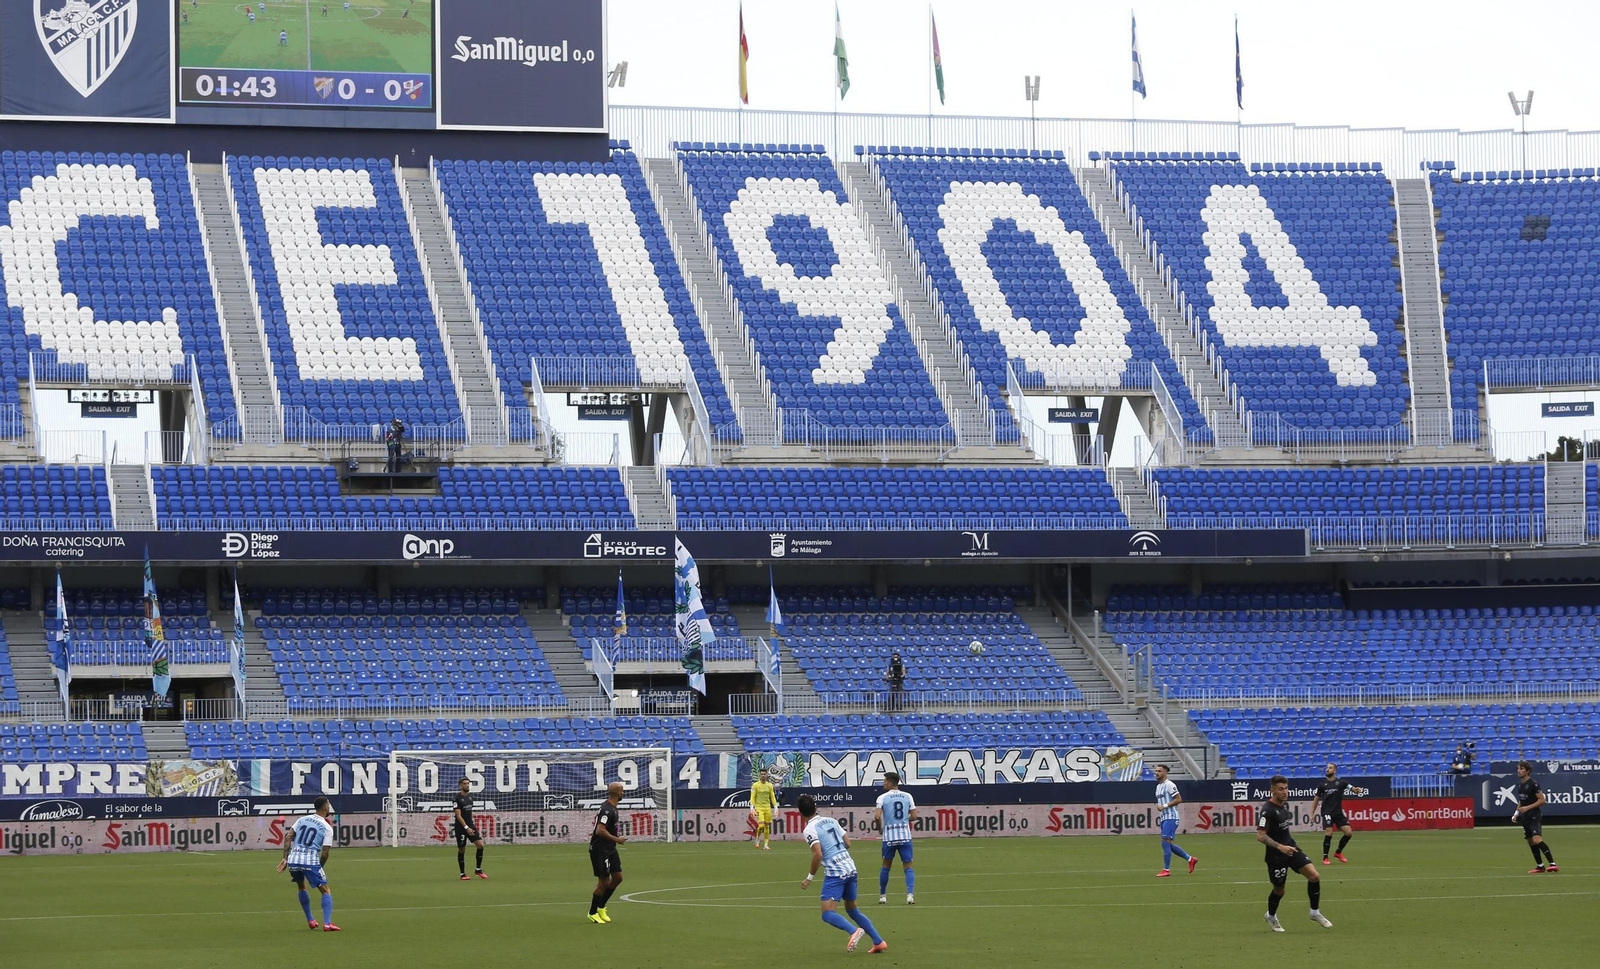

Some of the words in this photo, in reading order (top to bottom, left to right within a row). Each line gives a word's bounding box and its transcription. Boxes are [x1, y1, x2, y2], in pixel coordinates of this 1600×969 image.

[573, 49, 595, 64] 0,0
[196, 74, 276, 98] 01:43
[337, 78, 355, 100] 0
[383, 79, 401, 101] 0
[533, 174, 1378, 388] 1904
[3, 535, 39, 547] DOÑA
[42, 537, 126, 548] FRANCISQUITA
[251, 533, 279, 542] Diego
[251, 541, 272, 549] Díaz
[791, 539, 832, 547] Ayuntamiento
[45, 548, 84, 557] catering
[251, 549, 280, 558] López
[604, 547, 666, 556] PROTEC
[800, 546, 822, 555] Málaga
[291, 762, 439, 795] FONDO
[465, 760, 550, 792] SUR
[593, 756, 701, 791] 1904
[807, 750, 1102, 787] MALAKAS
[812, 793, 831, 801] abor
[833, 793, 843, 801] de
[845, 793, 853, 801] la
[106, 805, 113, 813] El
[116, 804, 139, 813] sabor
[141, 804, 153, 813] de
[155, 803, 163, 812] la
[894, 801, 904, 820] 8
[1348, 808, 1390, 823] LaLiga
[1407, 806, 1473, 822] SmartBank
[706, 822, 727, 836] 0,0
[1009, 818, 1029, 833] 0,0
[0, 826, 55, 855] iguel
[61, 834, 83, 850] 0,0
[226, 829, 248, 846] 0,0
[297, 825, 318, 847] 10
[827, 827, 841, 851] 7
[1274, 867, 1287, 878] 23
